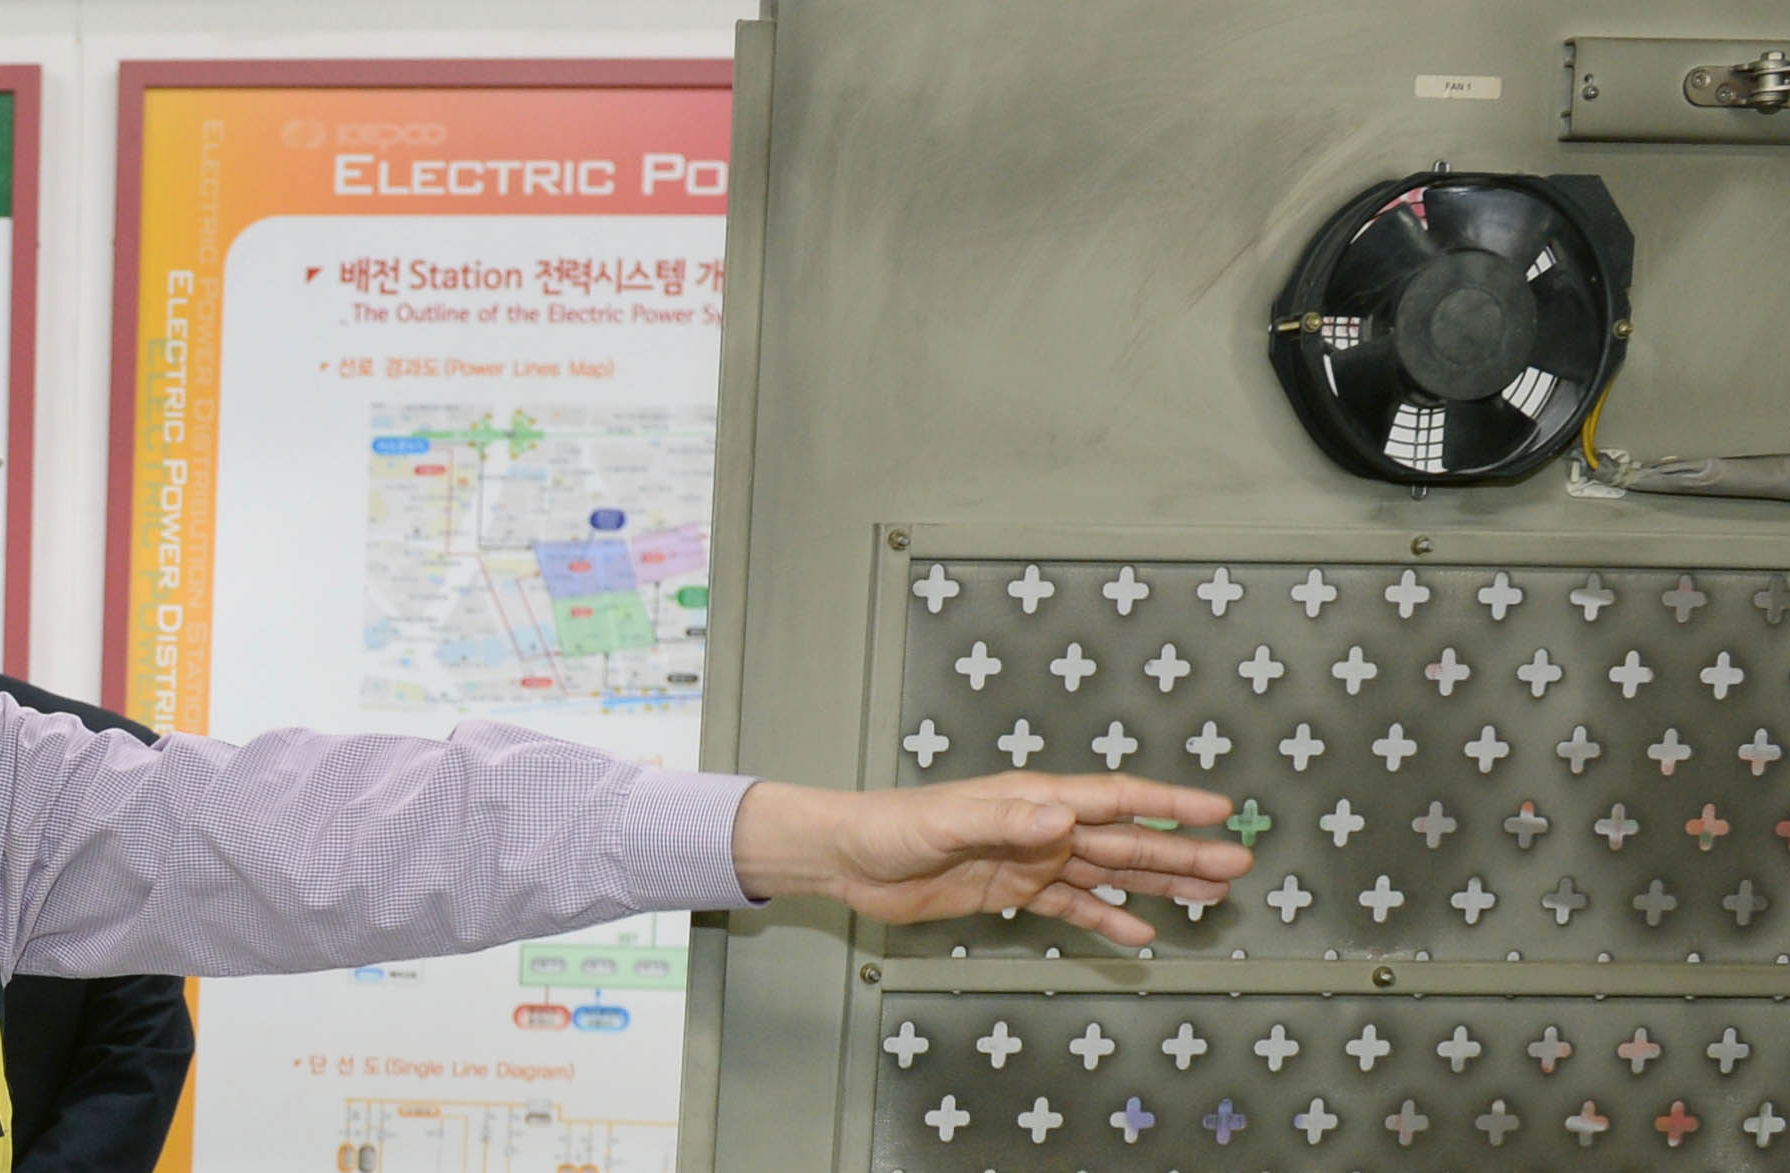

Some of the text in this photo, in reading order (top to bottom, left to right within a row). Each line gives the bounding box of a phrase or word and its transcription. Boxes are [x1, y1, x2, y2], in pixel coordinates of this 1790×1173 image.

[334, 153, 615, 195] ELECTRIC
[339, 257, 399, 296] 배전
[409, 258, 523, 291] Station
[535, 257, 687, 296] 전력시스템
[354, 303, 388, 323] The
[396, 303, 469, 323] Outline
[478, 303, 498, 323] of
[507, 303, 540, 323] the
[548, 303, 623, 323] Electric
[632, 303, 694, 324] Power
[163, 269, 194, 443] ELECTRIC
[158, 459, 188, 589] POWER
